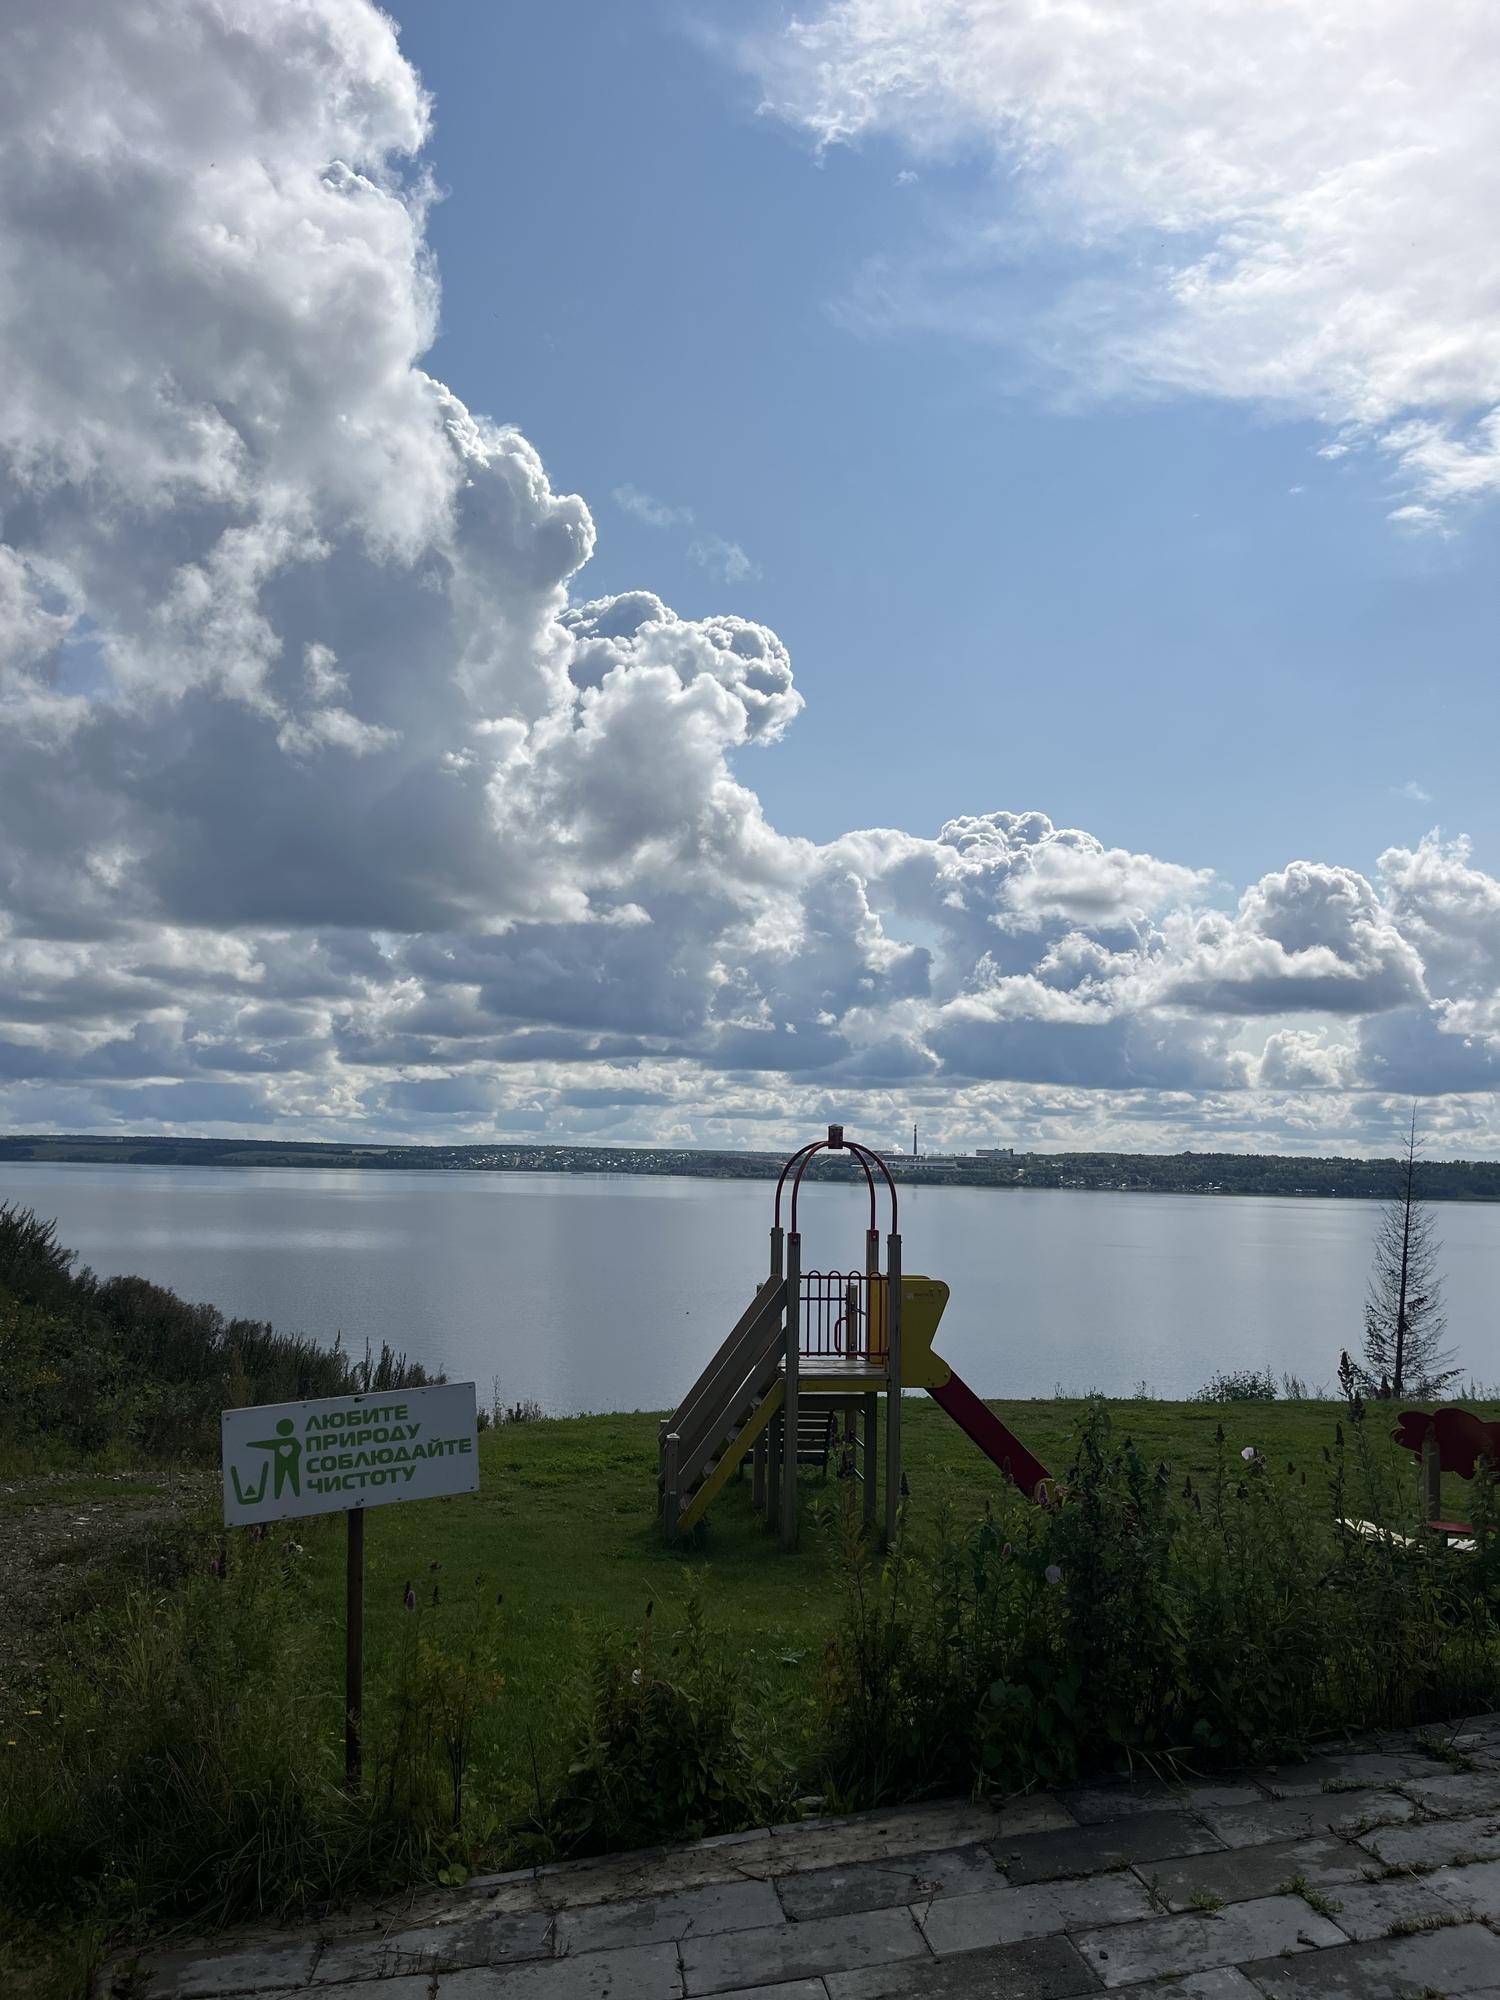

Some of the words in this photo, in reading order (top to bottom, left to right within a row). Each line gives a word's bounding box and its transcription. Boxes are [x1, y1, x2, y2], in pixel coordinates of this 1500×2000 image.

[306, 1405, 408, 1431] ЛЮБИТЕ
[306, 1423, 421, 1452] ПРИРОДУ
[306, 1438, 472, 1473] СОБЛЮДАЙТЕ
[306, 1465, 416, 1494] ЧИСТОТУ
